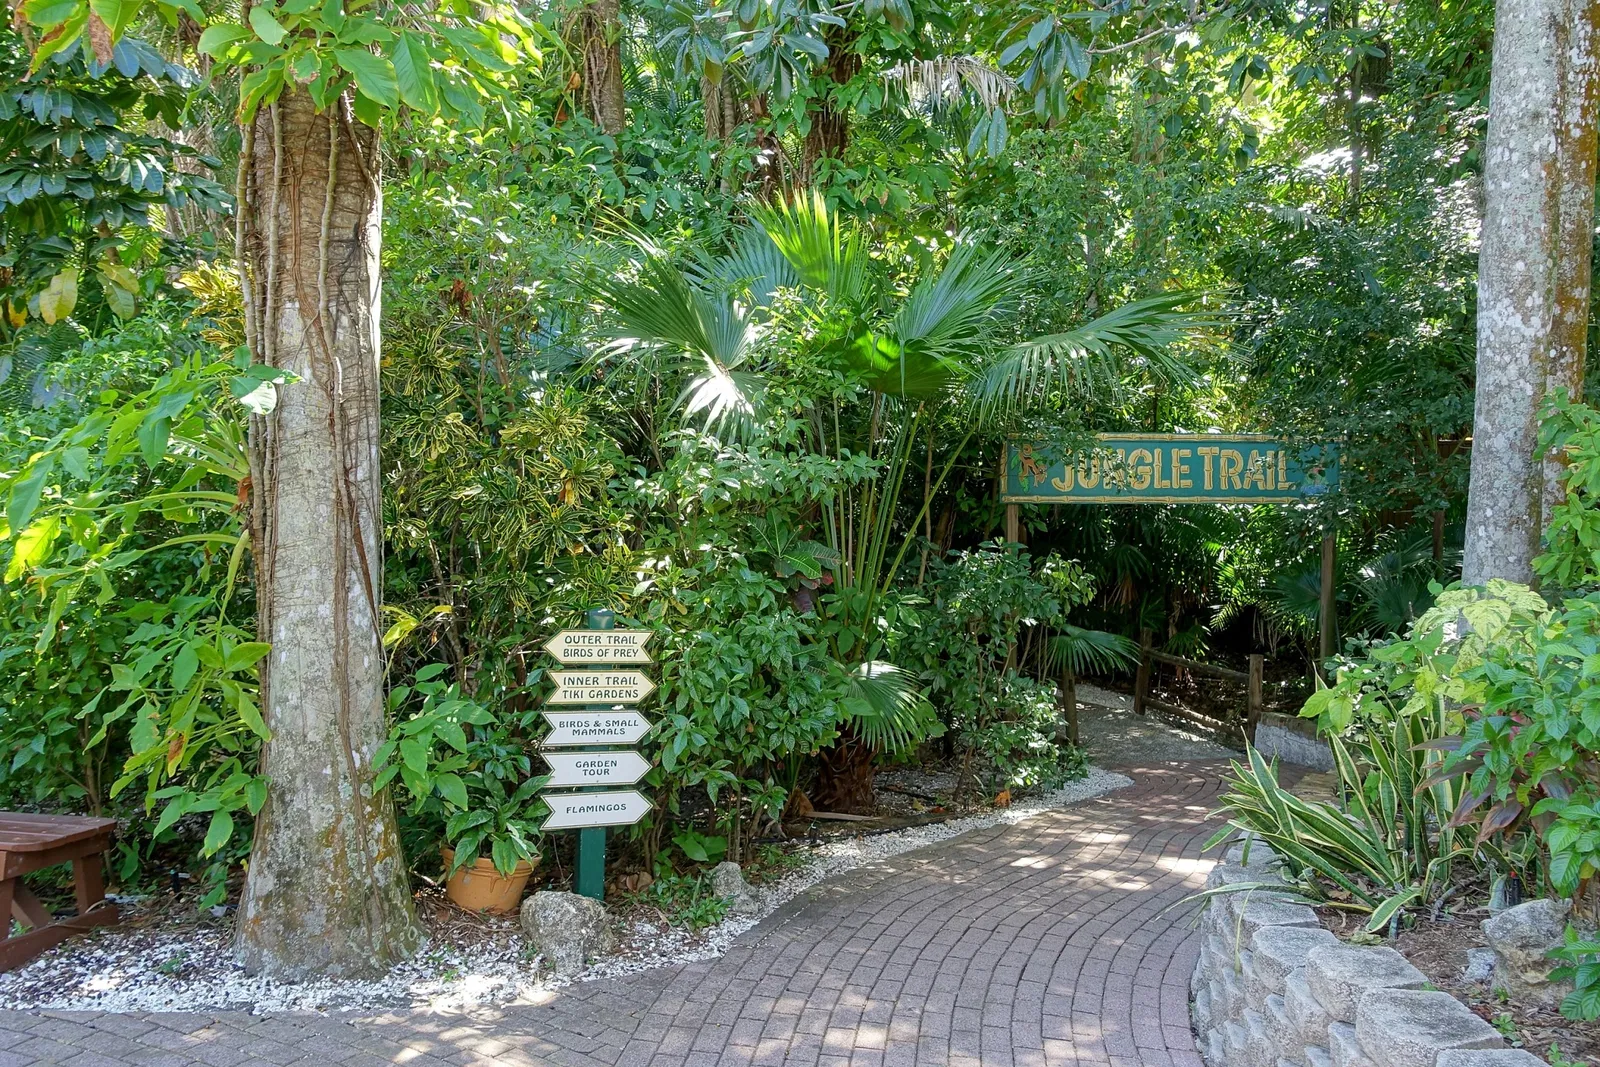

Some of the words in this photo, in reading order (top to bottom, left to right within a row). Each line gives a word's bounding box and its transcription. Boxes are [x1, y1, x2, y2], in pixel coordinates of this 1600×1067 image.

[1197, 446, 1296, 491] TRAIL
[564, 635, 602, 644] OUTER
[606, 635, 638, 644] TRAIL
[563, 648, 593, 657] BIRDS
[597, 648, 610, 657] OF
[613, 648, 639, 657] PREY
[563, 676, 599, 685] INNER
[605, 676, 638, 685] TRAIL
[562, 690, 584, 699] TIKI
[588, 689, 639, 698] GARDENS
[559, 720, 590, 728] BIRDS
[593, 720, 602, 728] &
[605, 719, 639, 727] SMALL
[572, 728, 626, 736] MAMMALS
[575, 760, 618, 768] GARDEN
[582, 768, 610, 776] TOUR
[566, 803, 627, 814] FLAMINGOS
